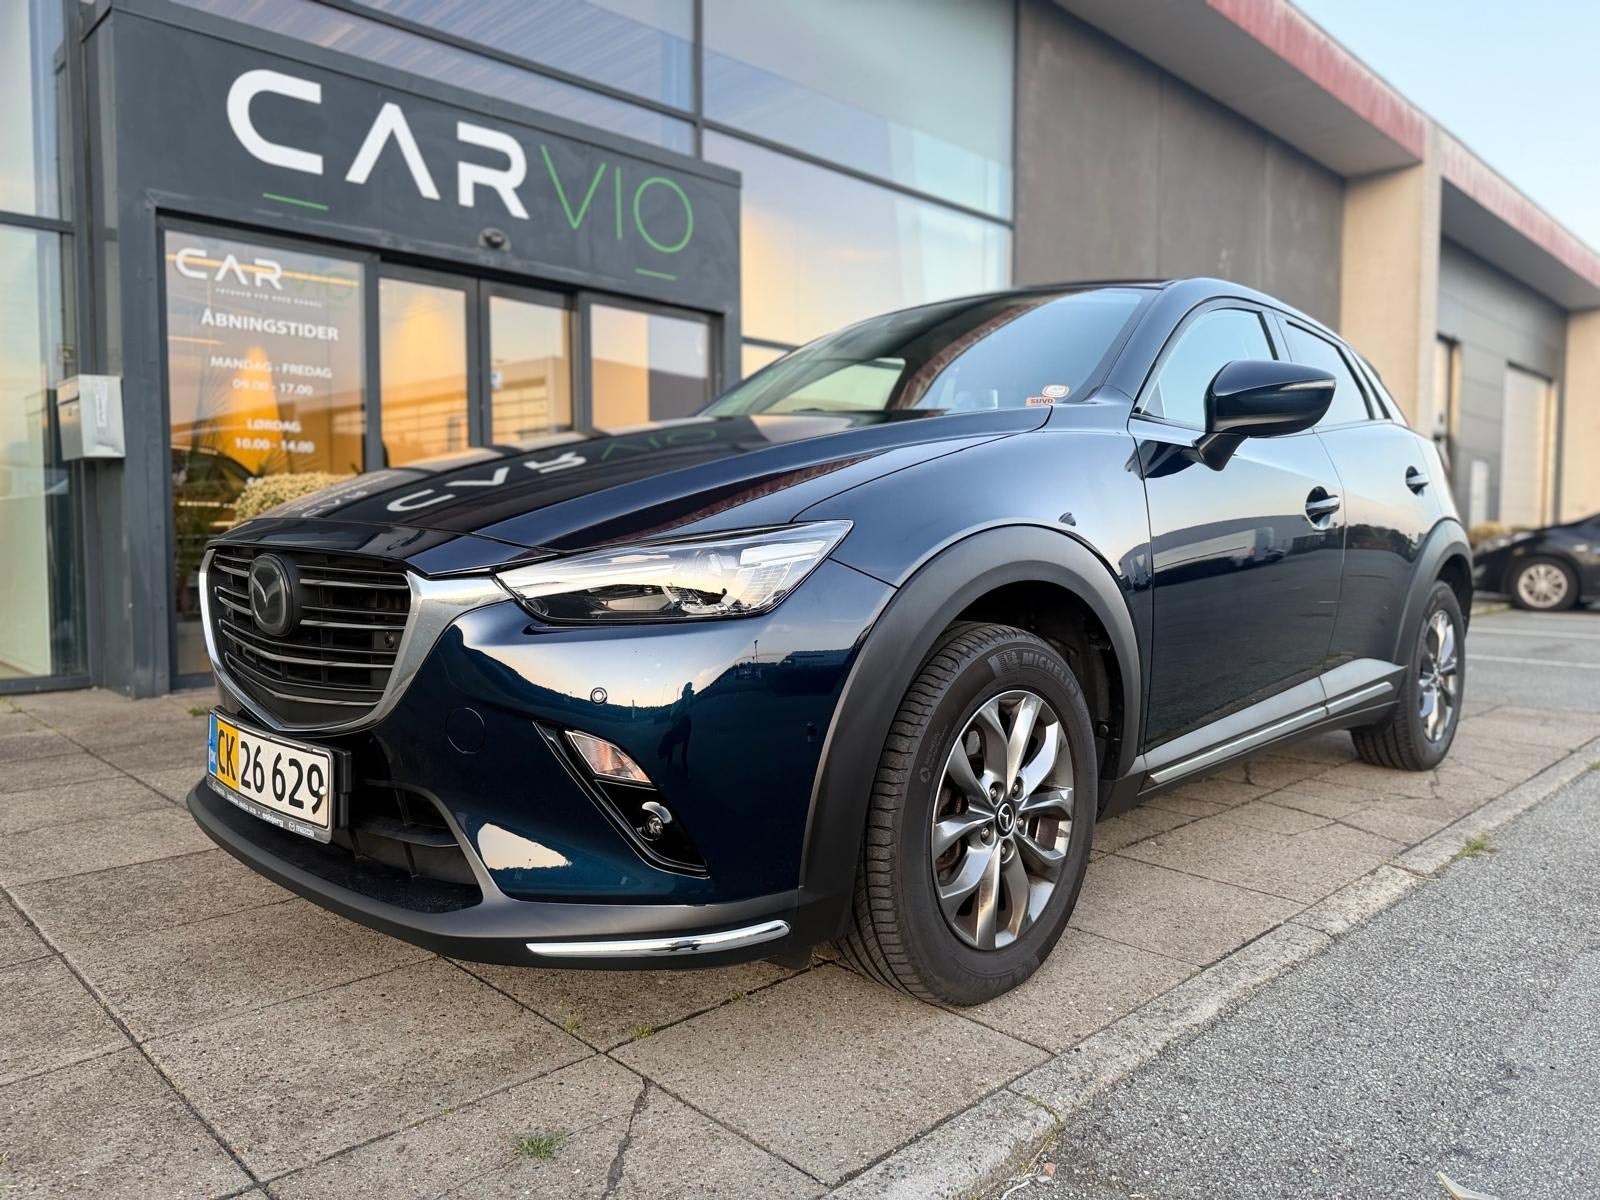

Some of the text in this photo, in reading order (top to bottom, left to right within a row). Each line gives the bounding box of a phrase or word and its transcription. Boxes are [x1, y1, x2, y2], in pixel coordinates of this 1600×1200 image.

[201, 308, 339, 341] ÅBNINGSTIDER
[210, 356, 272, 372] MANDAG
[282, 363, 332, 379] FREDAG
[280, 382, 314, 396] 17.00
[246, 418, 302, 433] LØRDAG
[235, 437, 270, 450] 10.00
[1021, 651, 1077, 696] MICHELIN
[217, 728, 325, 815] CK 26 629
